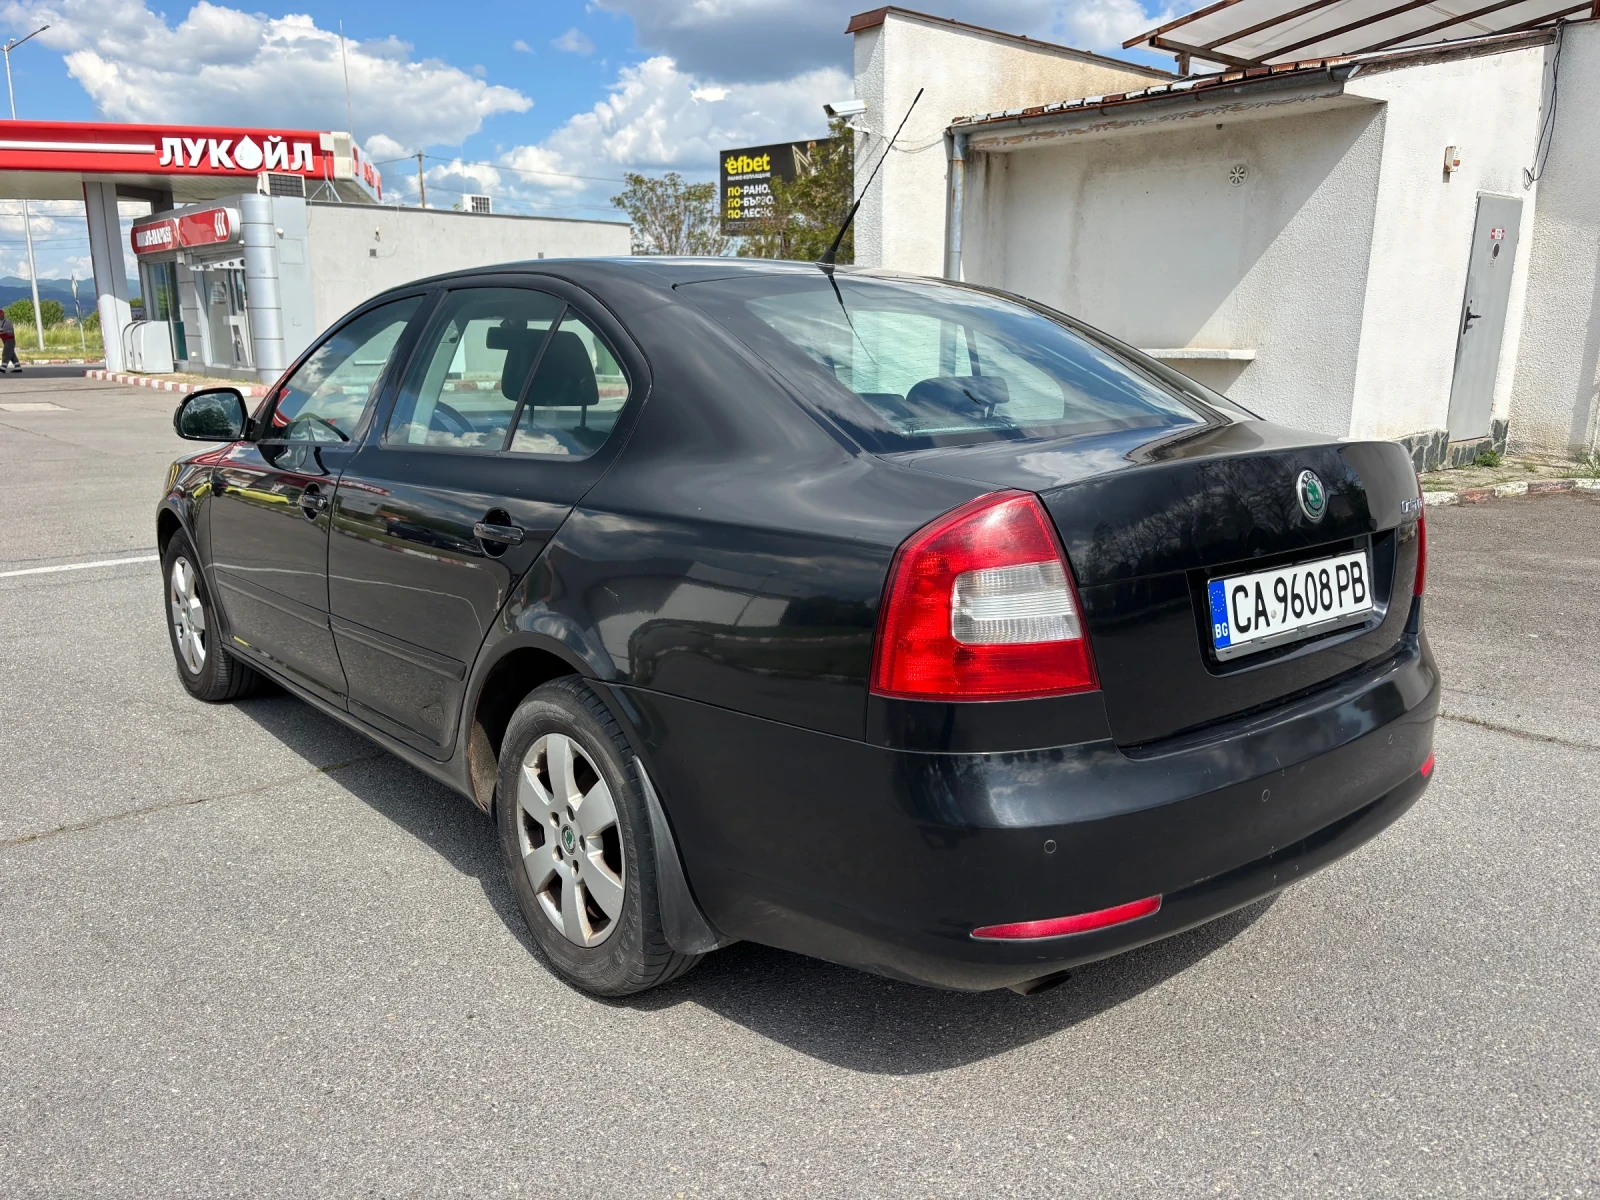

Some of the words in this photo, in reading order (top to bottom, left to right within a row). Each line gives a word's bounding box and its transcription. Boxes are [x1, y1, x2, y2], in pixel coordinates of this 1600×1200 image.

[726, 152, 770, 174] efbet
[1231, 580, 1271, 634] CA
[1273, 567, 1333, 624] 9608
[1335, 560, 1367, 608] PB
[1214, 622, 1229, 639] BG
